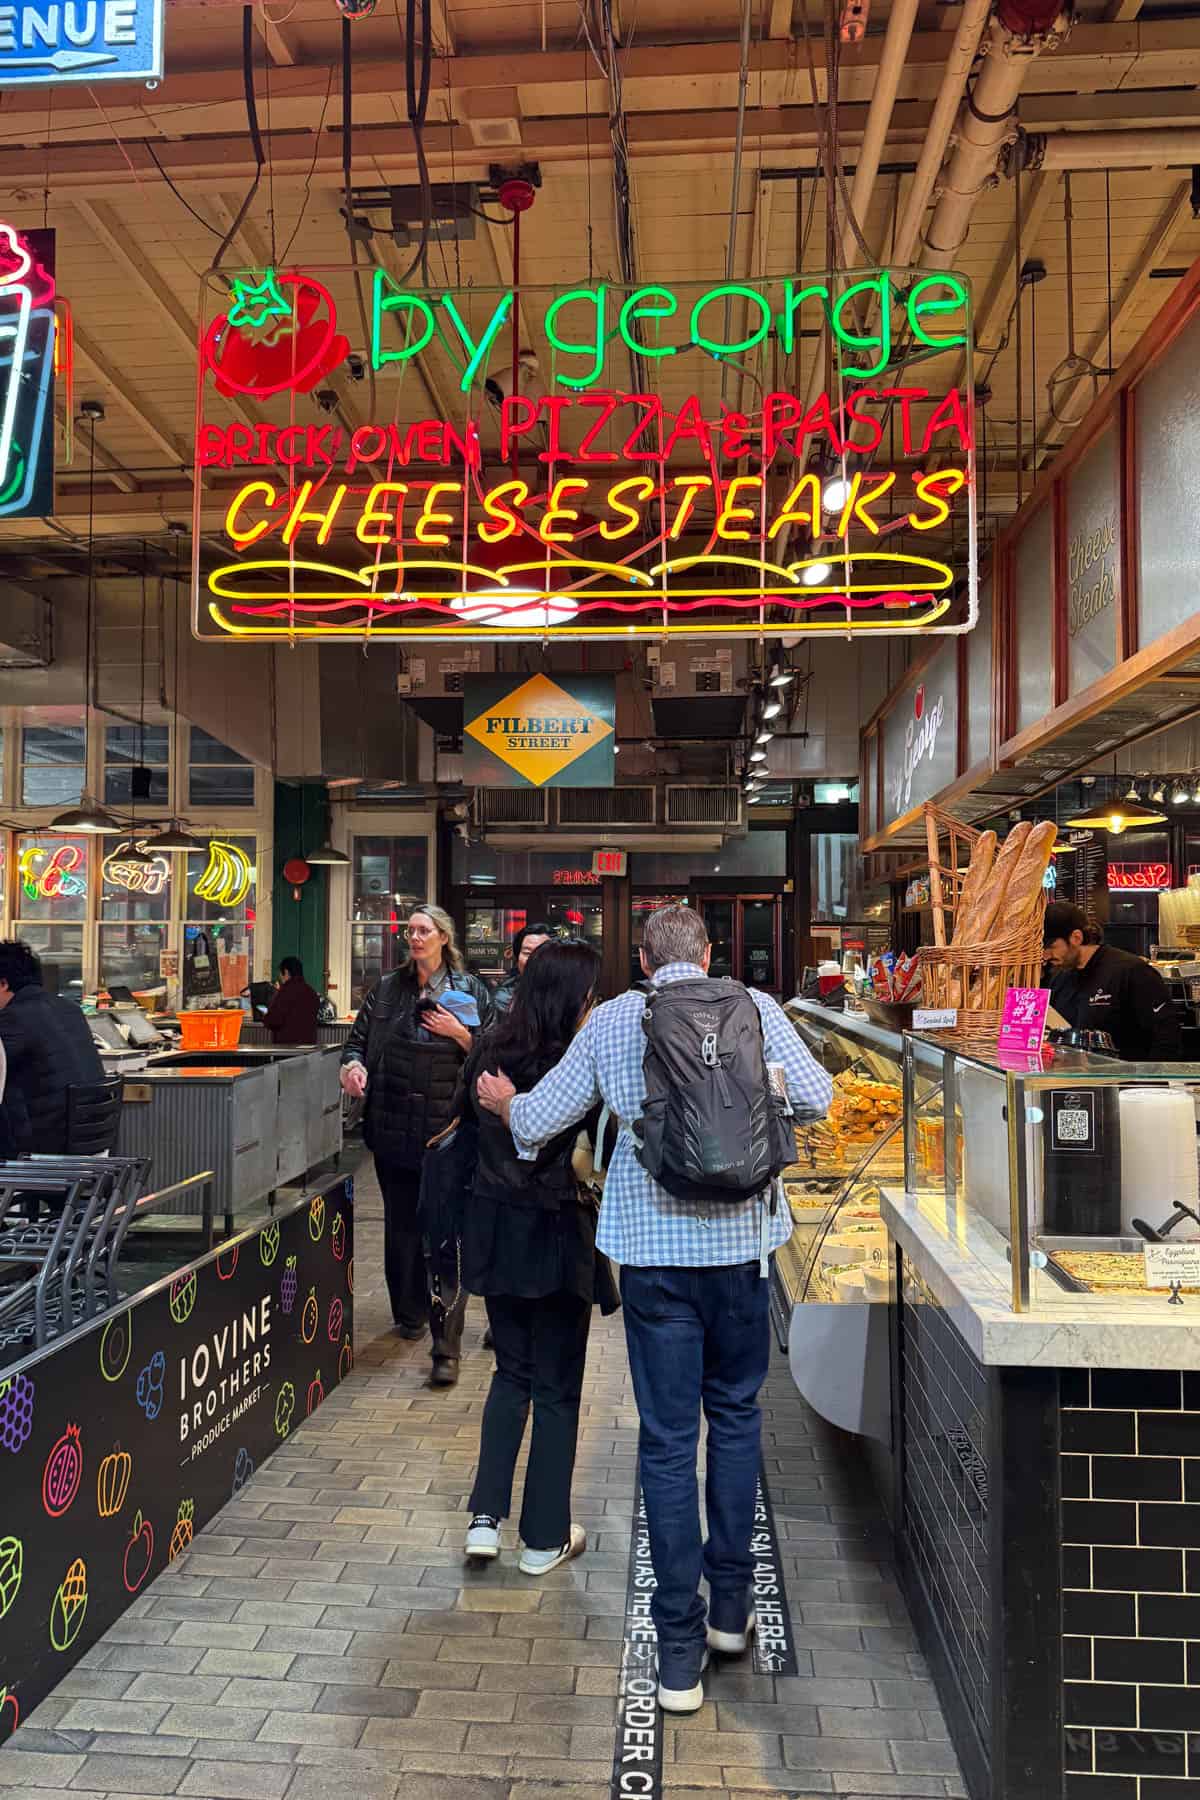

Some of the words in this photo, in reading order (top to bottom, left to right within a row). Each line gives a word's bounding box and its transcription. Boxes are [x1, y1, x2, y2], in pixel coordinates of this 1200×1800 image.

[372, 269, 514, 392] by
[544, 271, 968, 389] george
[200, 422, 334, 467] BRICK
[351, 420, 480, 466] OVEN
[501, 394, 712, 463] PIZZA
[763, 388, 974, 459] PASTA
[225, 468, 966, 545] CHEESESTEAKS
[486, 717, 594, 734] FILBERT
[508, 737, 571, 748] STREET
[597, 852, 623, 872] EXIT
[180, 1295, 272, 1401] IOVINE
[180, 1343, 271, 1442] BROTHERS
[191, 1413, 232, 1461] PRODUCE
[232, 1385, 262, 1425] MARKET
[756, 1599, 787, 1652] HERE
[622, 1678, 657, 1763] ORDER
